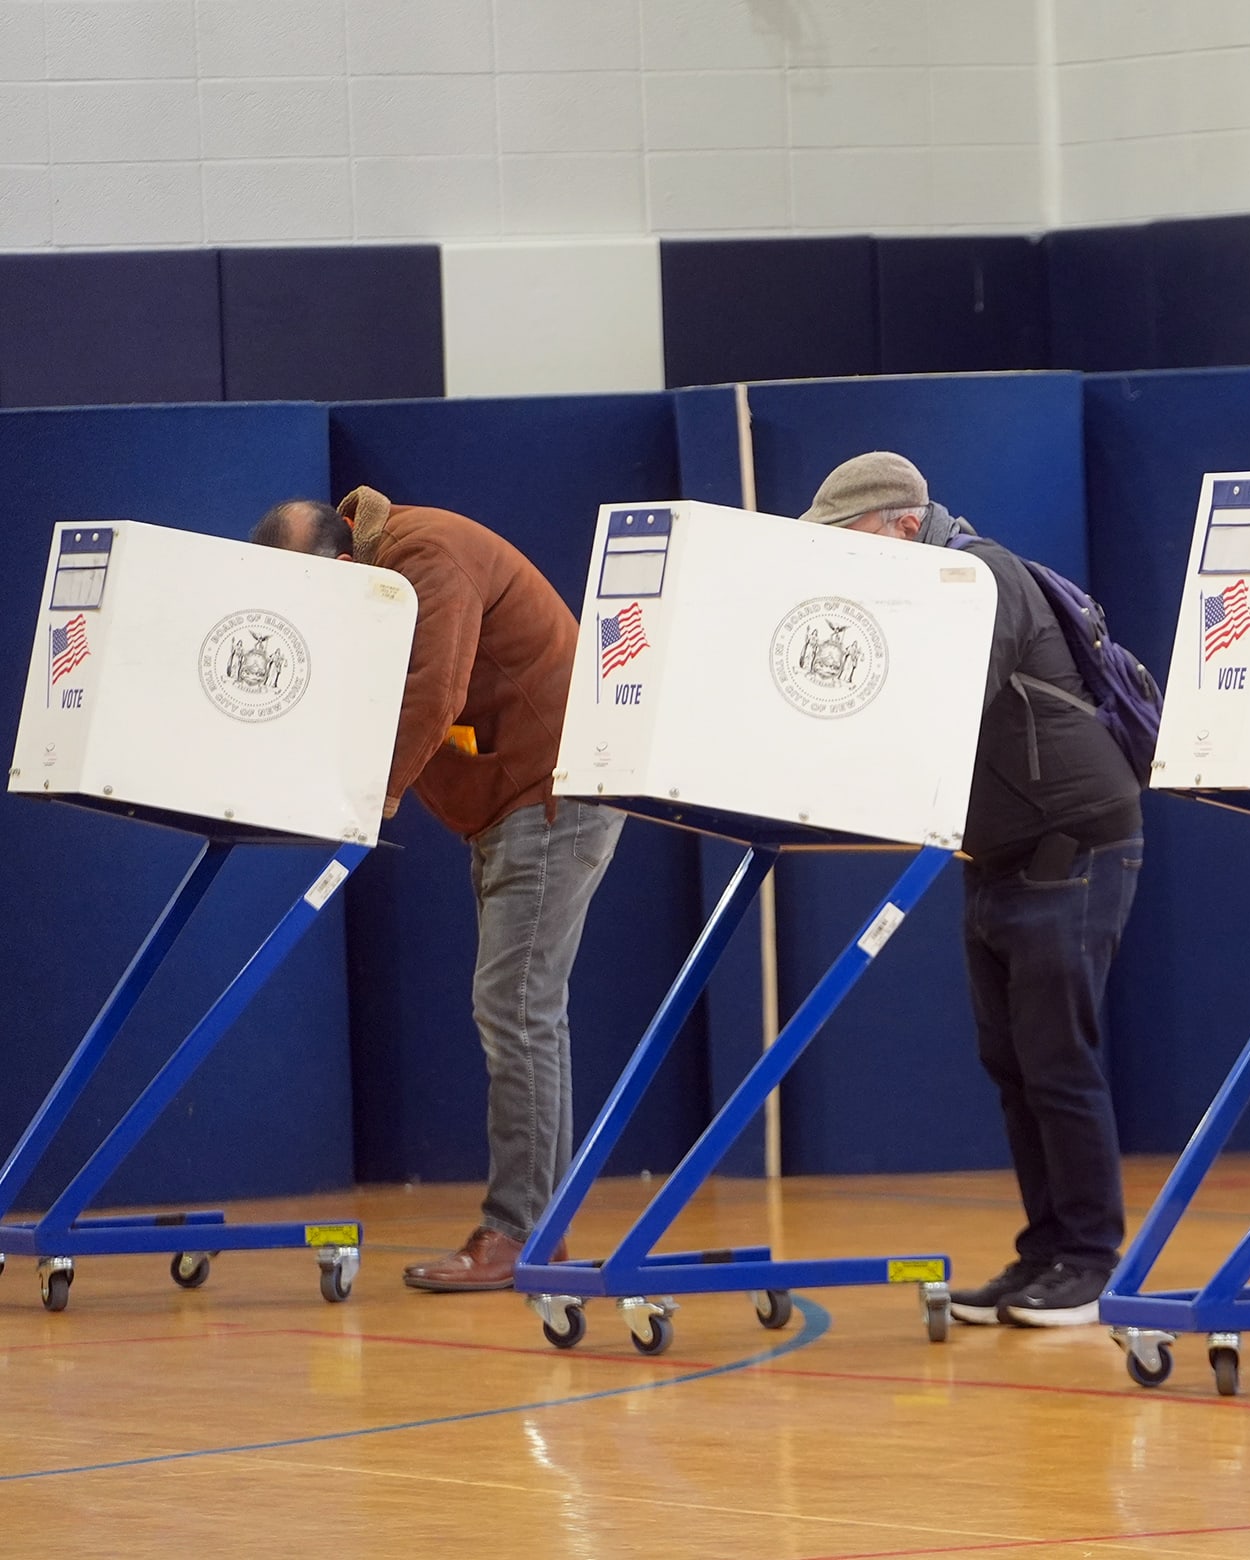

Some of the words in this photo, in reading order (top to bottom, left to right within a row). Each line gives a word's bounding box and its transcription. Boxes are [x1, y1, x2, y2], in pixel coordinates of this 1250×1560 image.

[824, 602, 840, 611] OF
[1218, 667, 1247, 690] VOTE
[62, 688, 83, 709] VOTE
[615, 684, 643, 705] VOTE
